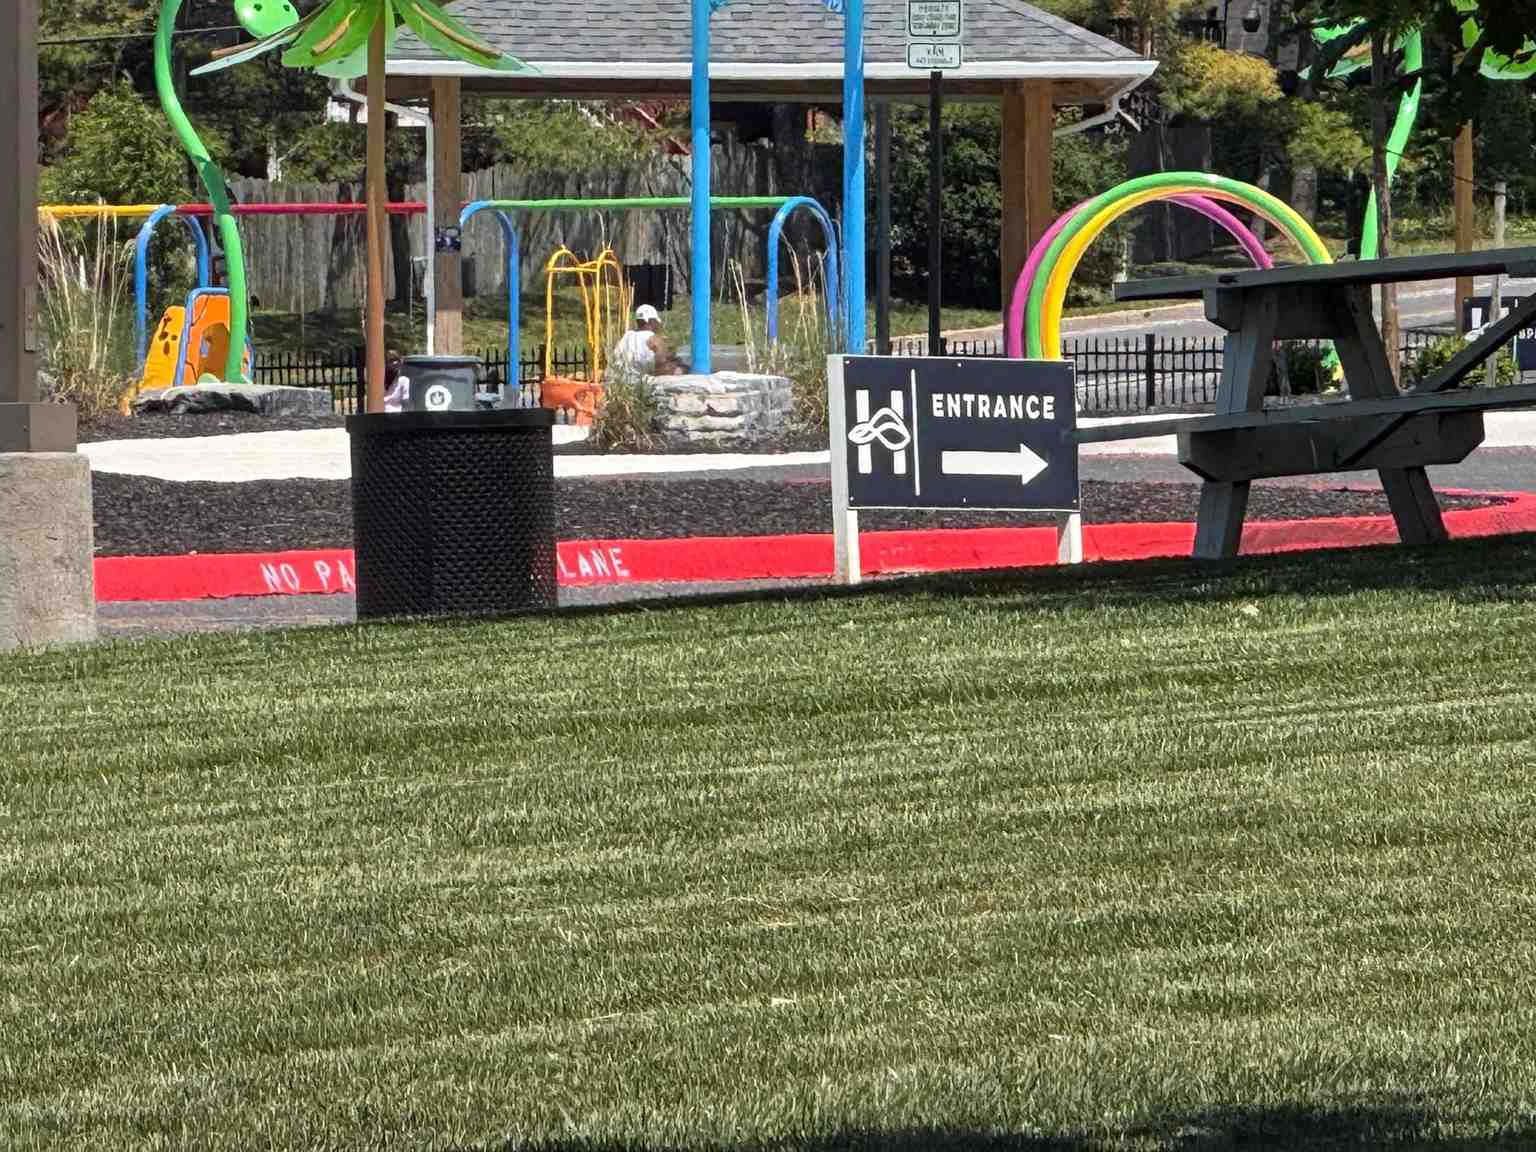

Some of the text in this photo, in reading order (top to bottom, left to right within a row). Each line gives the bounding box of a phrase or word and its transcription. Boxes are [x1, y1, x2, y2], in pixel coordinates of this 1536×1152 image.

[931, 392, 1056, 420] ENTRANCE
[259, 561, 300, 592] NO
[556, 547, 630, 578] LANE
